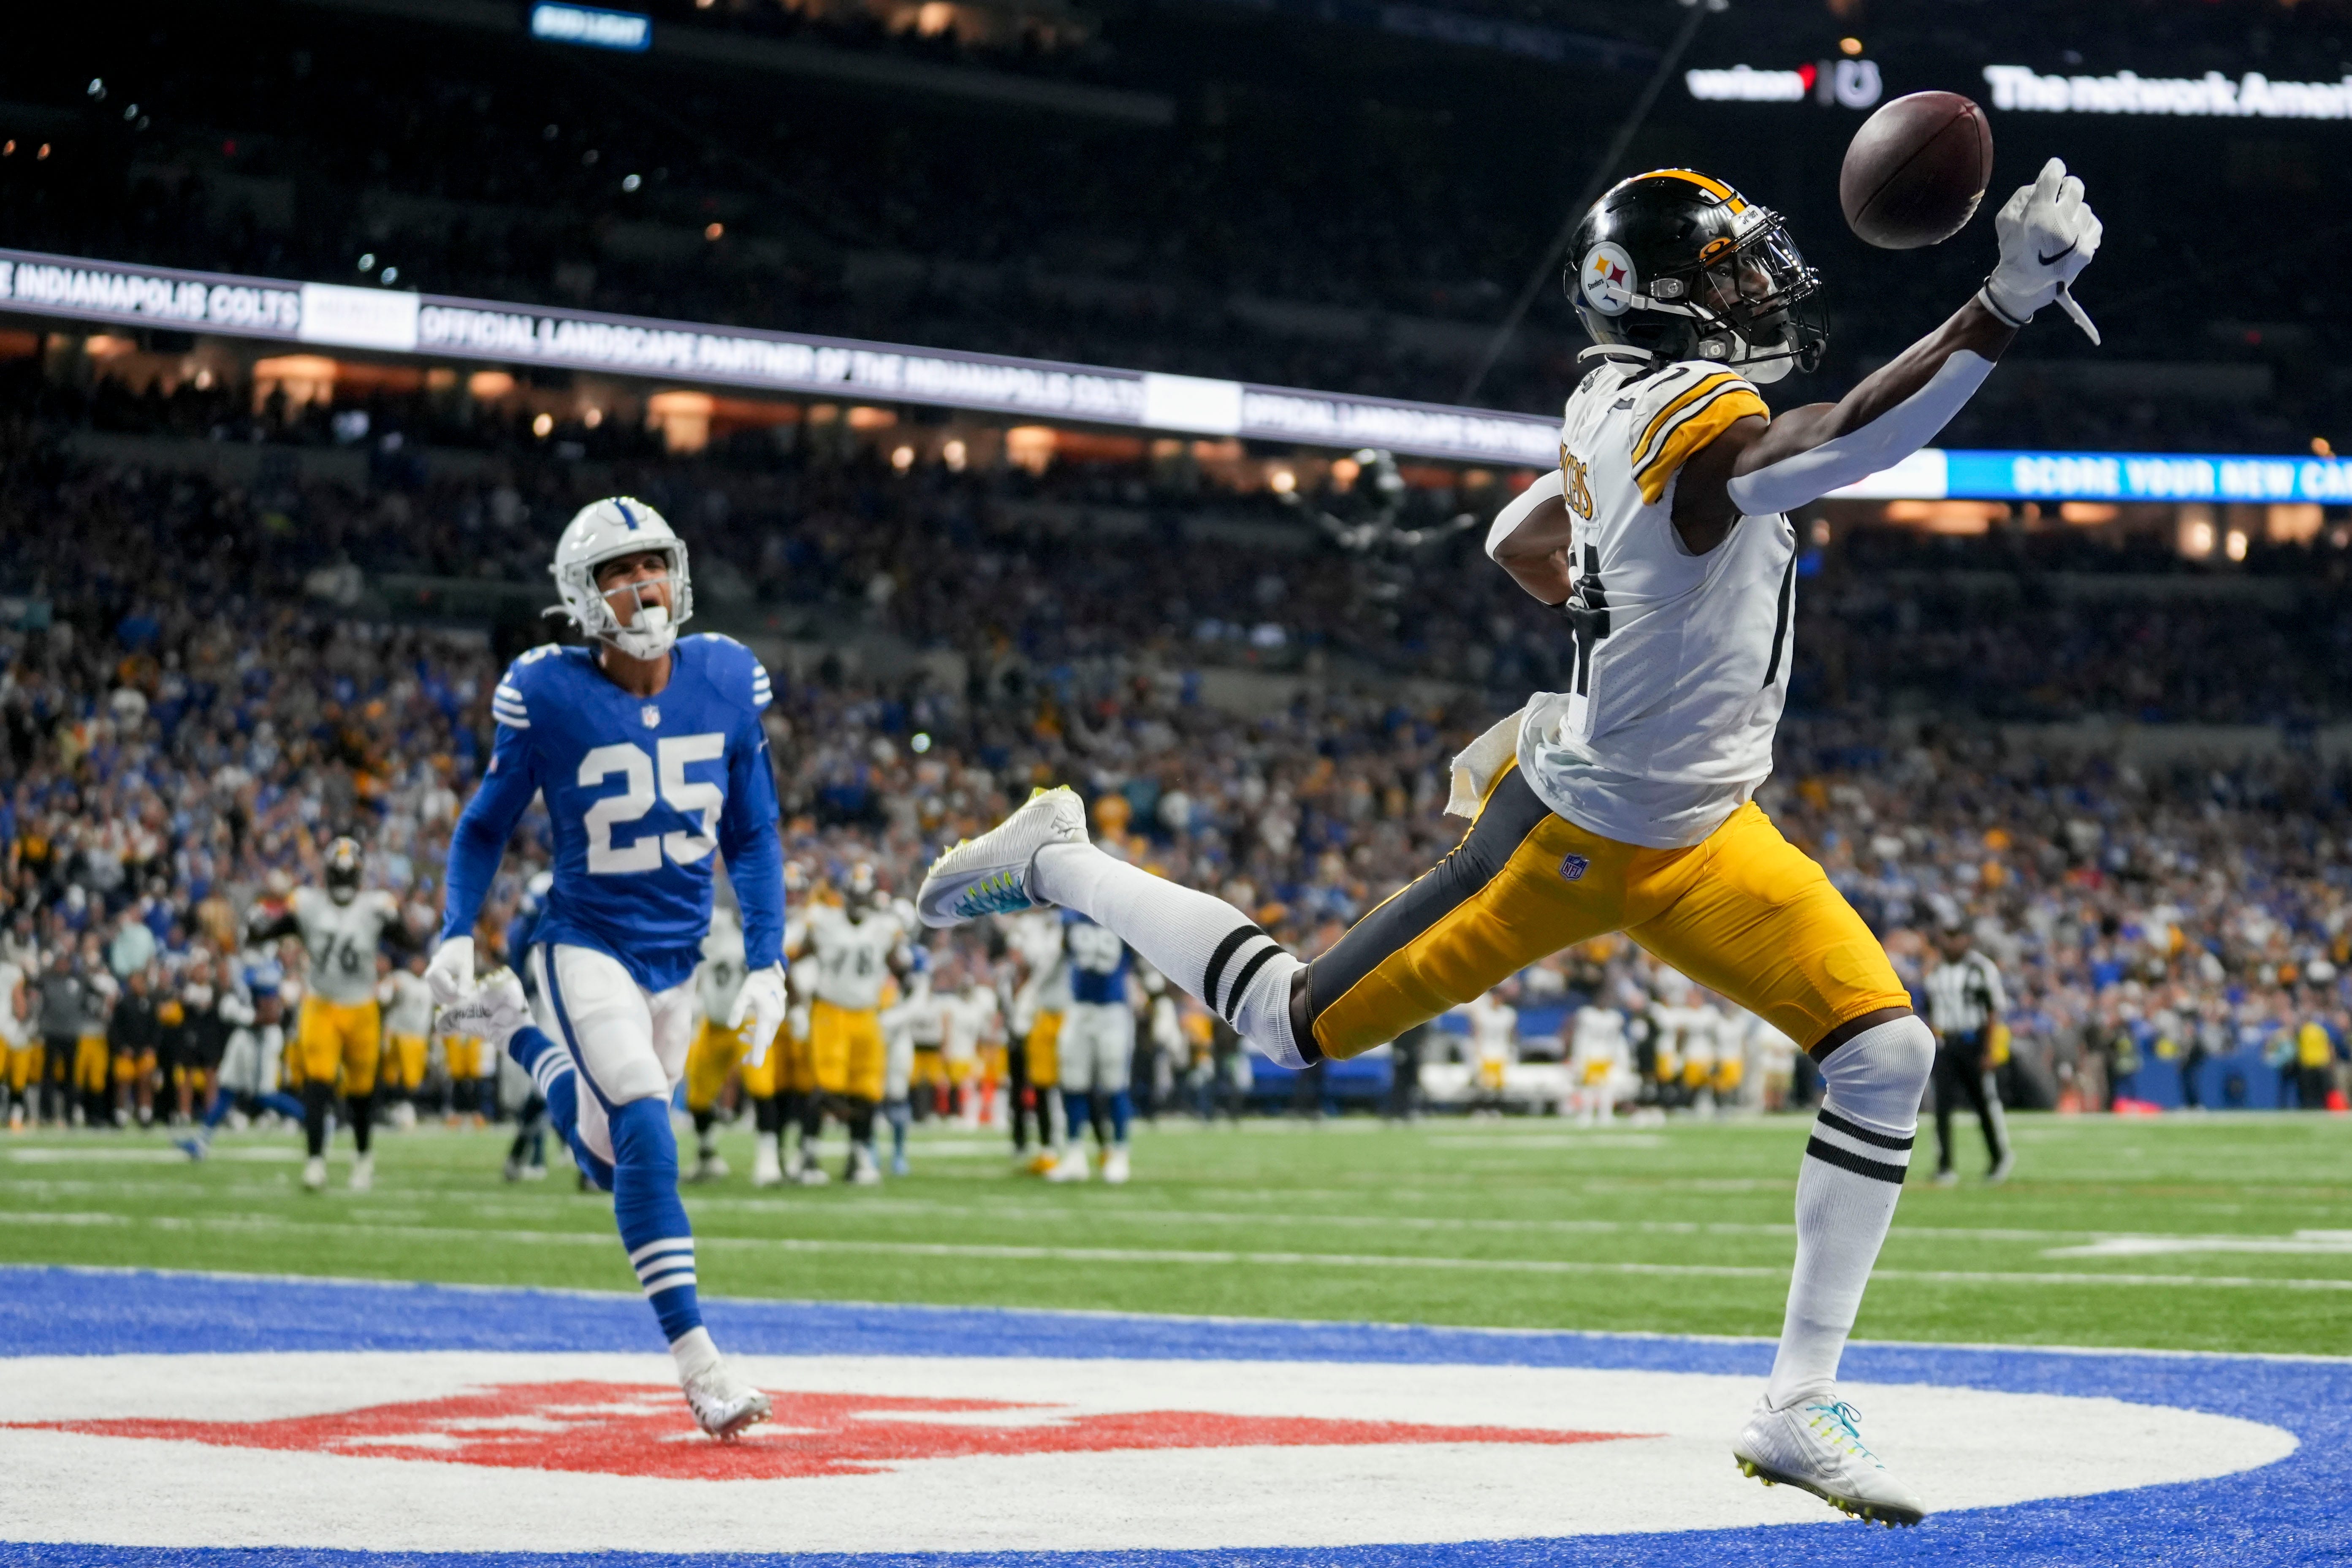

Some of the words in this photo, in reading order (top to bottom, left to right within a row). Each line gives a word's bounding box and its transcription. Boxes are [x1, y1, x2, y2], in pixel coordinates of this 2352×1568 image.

[1983, 65, 2070, 112] The
[15, 263, 206, 319] INDIANAPOLIS
[208, 284, 299, 328] COLTS
[1587, 279, 1604, 290] Steelers
[420, 305, 535, 353] OFFICIAL
[538, 317, 694, 369] LANDSCAPE
[697, 332, 814, 380] PARTNER
[816, 346, 850, 383] OF
[850, 348, 903, 391] THE
[905, 356, 1072, 410] INDIANAPOLIS
[2013, 456, 2120, 496] SCORE
[2126, 458, 2214, 496] YOUR
[2220, 460, 2295, 497] NEW
[578, 732, 725, 874] 25
[1563, 863, 1579, 877] NFL
[317, 930, 360, 976] 76
[1069, 923, 1122, 972] 99
